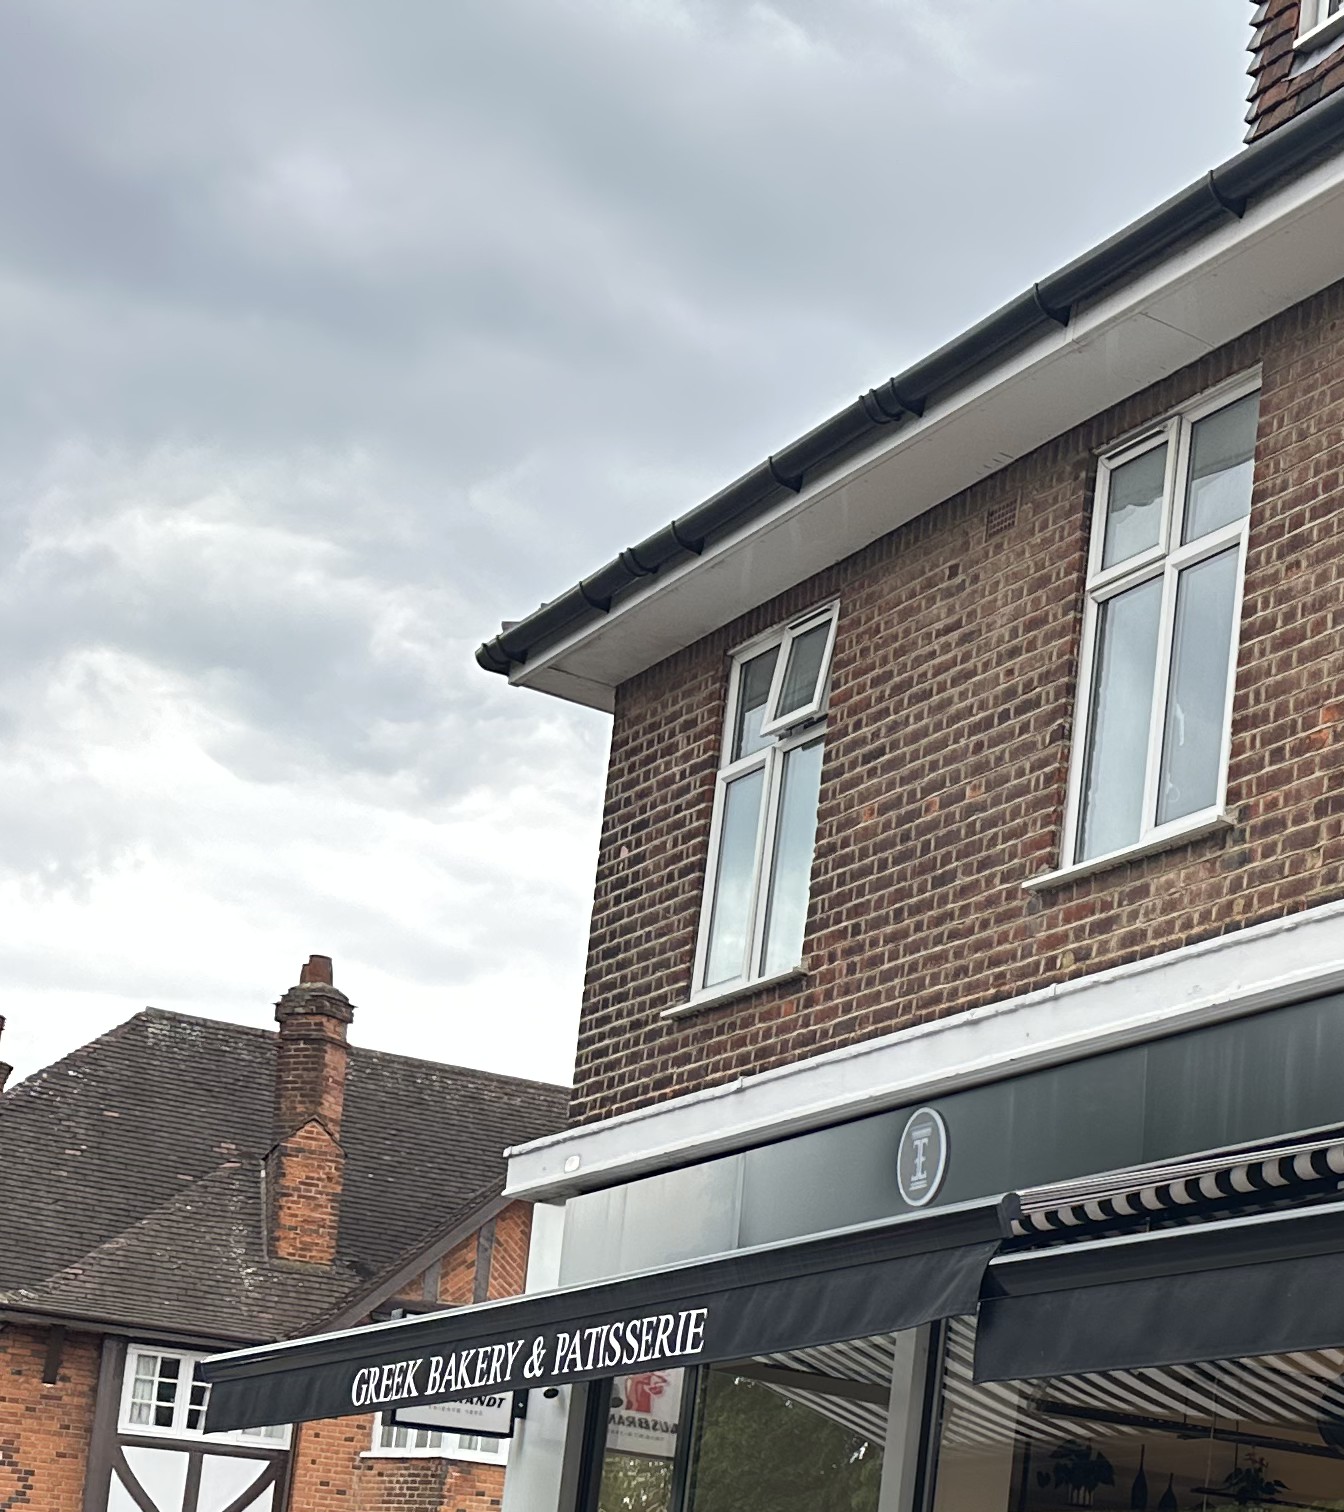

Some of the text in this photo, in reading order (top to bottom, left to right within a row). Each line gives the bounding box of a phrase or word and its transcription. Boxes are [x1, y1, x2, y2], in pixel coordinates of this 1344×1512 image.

[351, 1308, 708, 1407] GREEK BAKERY & PATISSERIE
